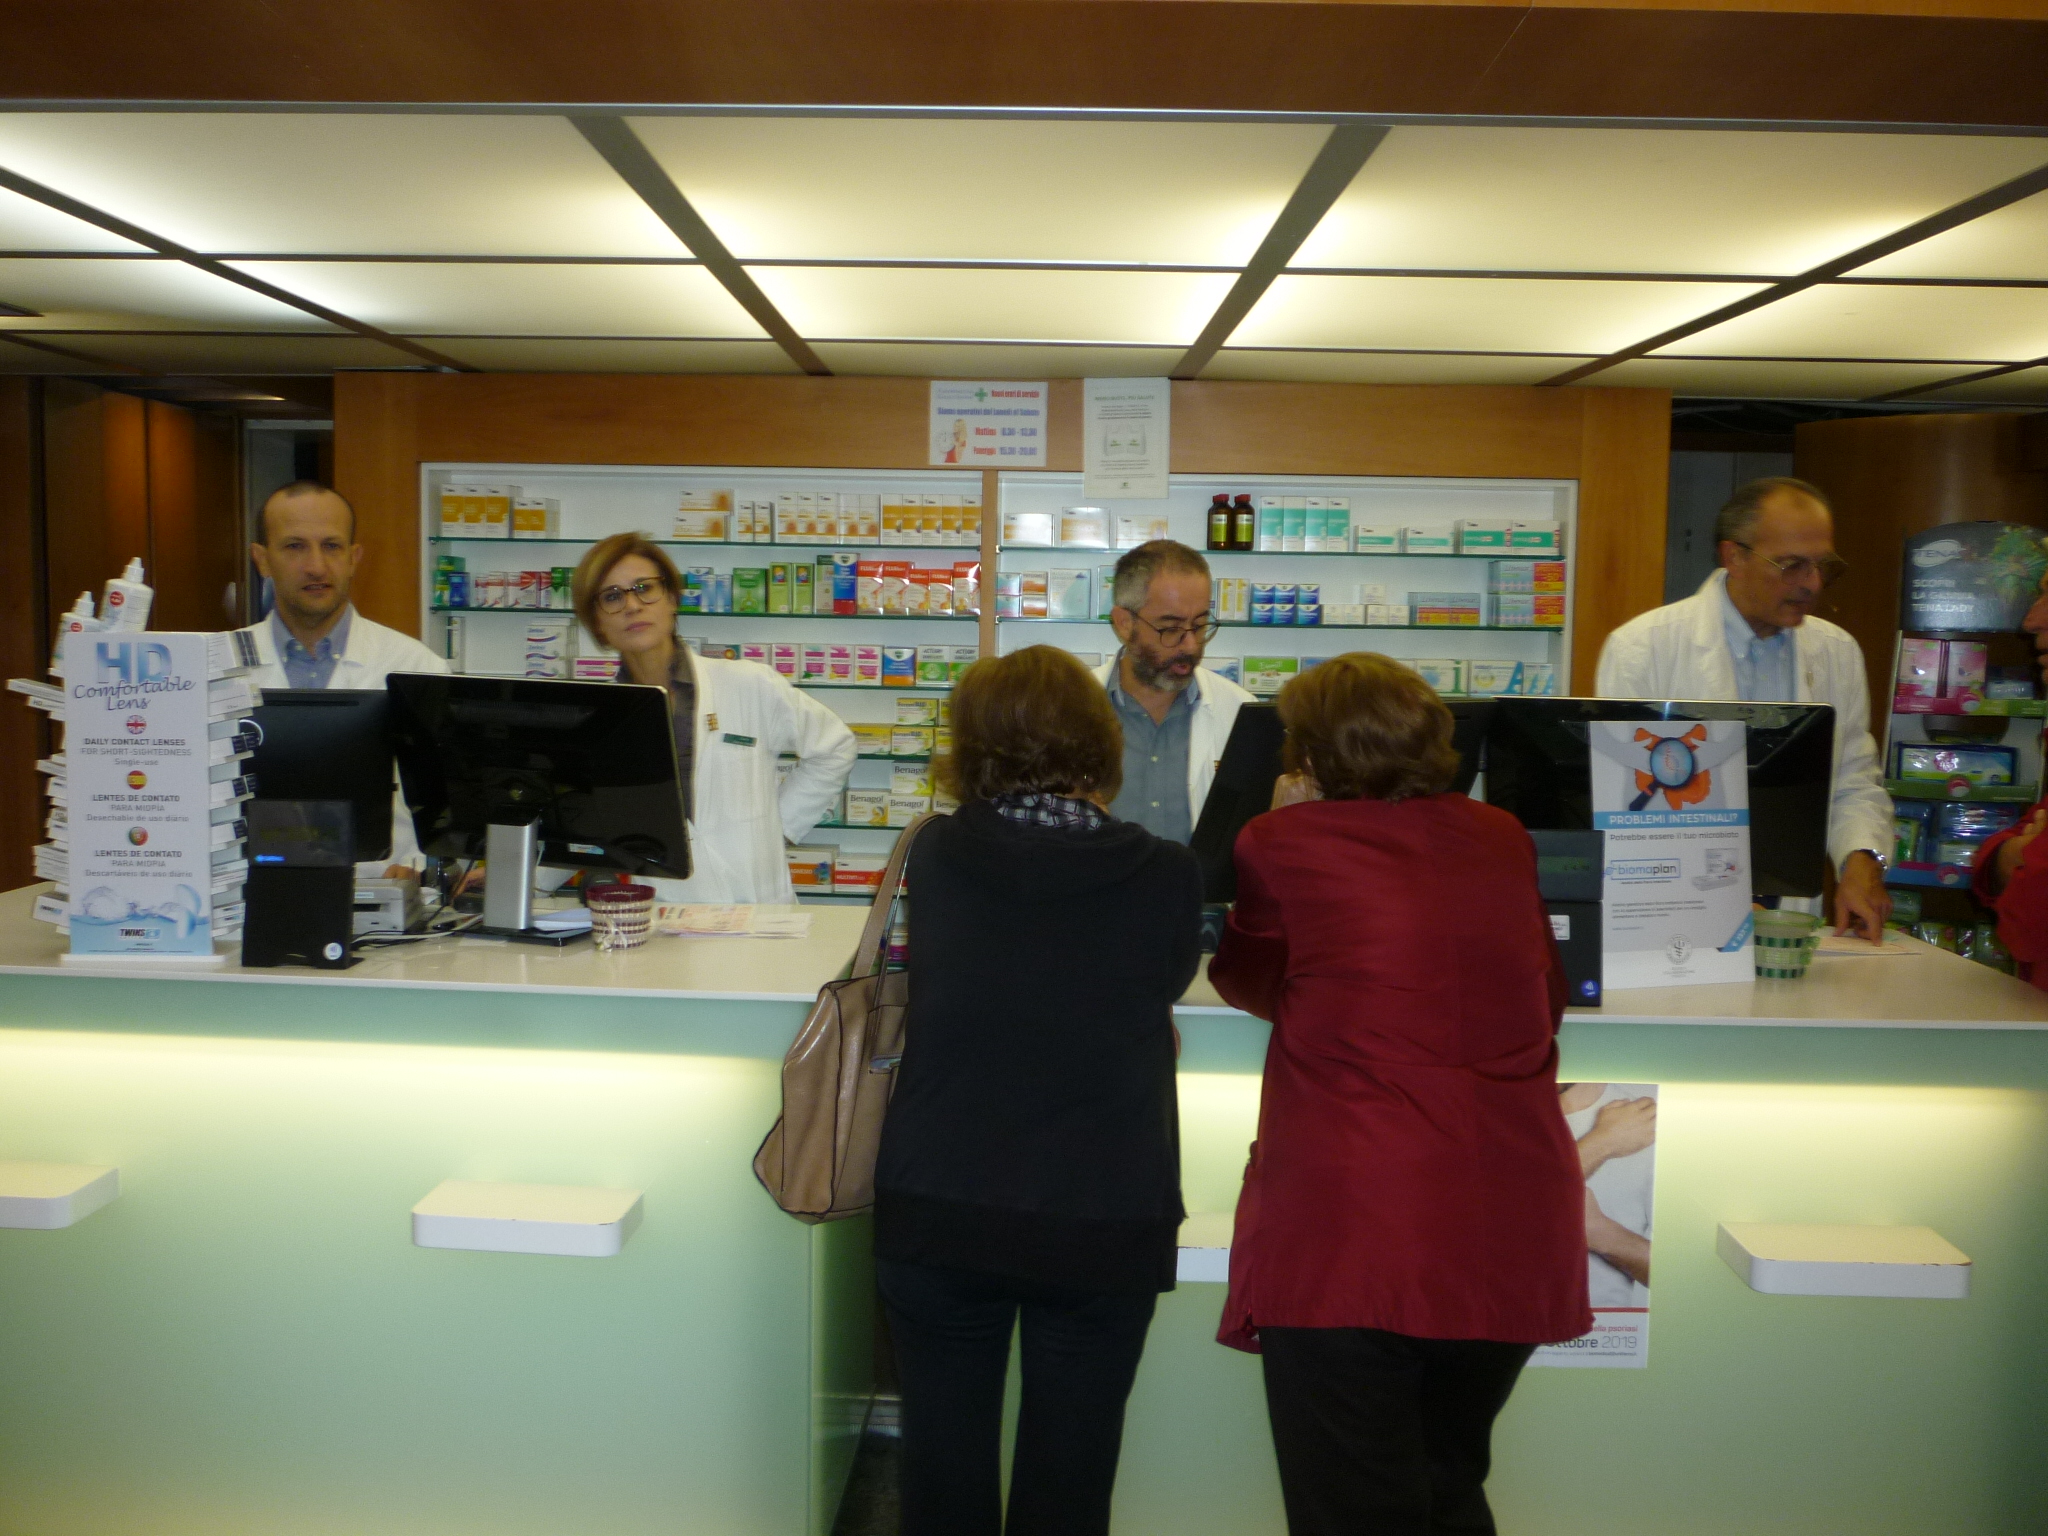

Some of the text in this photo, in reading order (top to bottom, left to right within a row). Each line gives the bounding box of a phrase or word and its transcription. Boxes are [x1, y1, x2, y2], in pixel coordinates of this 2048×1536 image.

[1912, 604, 1975, 612] TENA LADY
[96, 642, 172, 685] HD
[74, 676, 197, 699] Comfortable
[106, 697, 152, 711] Lens
[84, 738, 109, 746] DAILY
[111, 738, 150, 746] CONTACT
[100, 748, 192, 756] SHORT-SIGHTEDNESS
[850, 795, 884, 804] Benagol
[890, 799, 925, 808] Benagol
[1609, 812, 1738, 825] PROBLEMI INTESTINALI?
[1610, 833, 1647, 841] Potrebbe
[1649, 833, 1675, 841] essere
[1684, 832, 1697, 840] tuo
[144, 850, 183, 858] CONTATO
[1618, 863, 1677, 876] biomaplan
[1608, 1325, 1638, 1333] psoriasi
[1602, 1336, 1637, 1349] 2019
